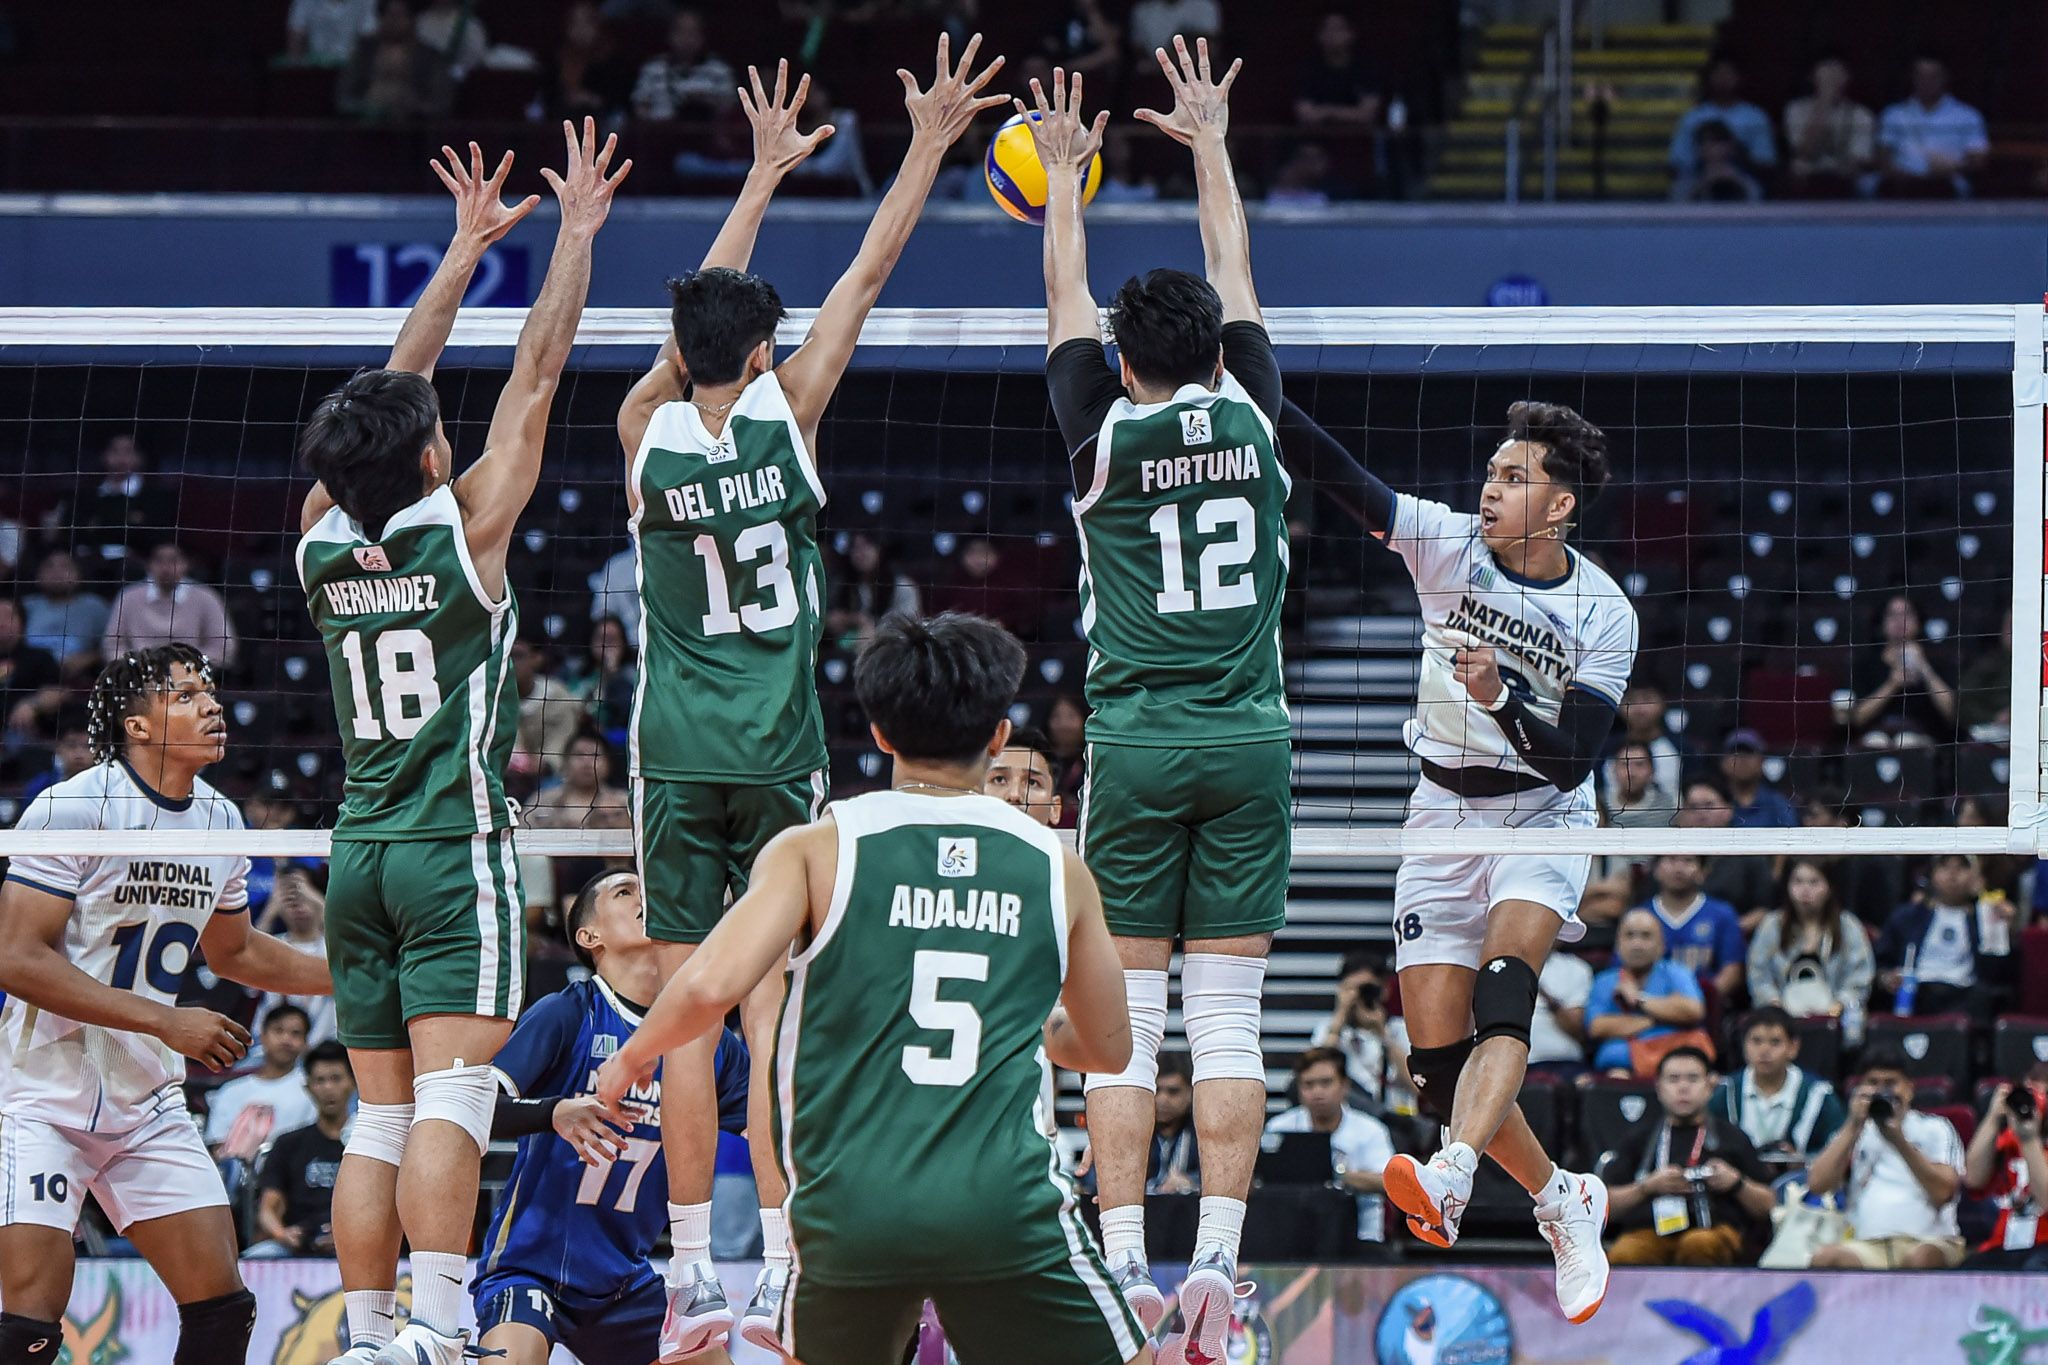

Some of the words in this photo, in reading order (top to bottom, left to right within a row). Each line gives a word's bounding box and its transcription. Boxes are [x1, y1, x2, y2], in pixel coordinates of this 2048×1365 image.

[664, 482, 715, 522] DEL
[718, 465, 787, 513] PILAR
[1141, 443, 1261, 493] FORTUNA
[693, 520, 800, 636] 13
[1150, 496, 1258, 614] 12
[323, 574, 439, 615] HERNANDEZ
[1459, 594, 1567, 659] NATIONAL
[342, 629, 442, 740] 18
[889, 884, 1022, 938] ADAJAR
[110, 920, 199, 994] 10
[901, 950, 990, 1087] 5
[29, 1172, 68, 1203] 10
[575, 1136, 663, 1213] 17
